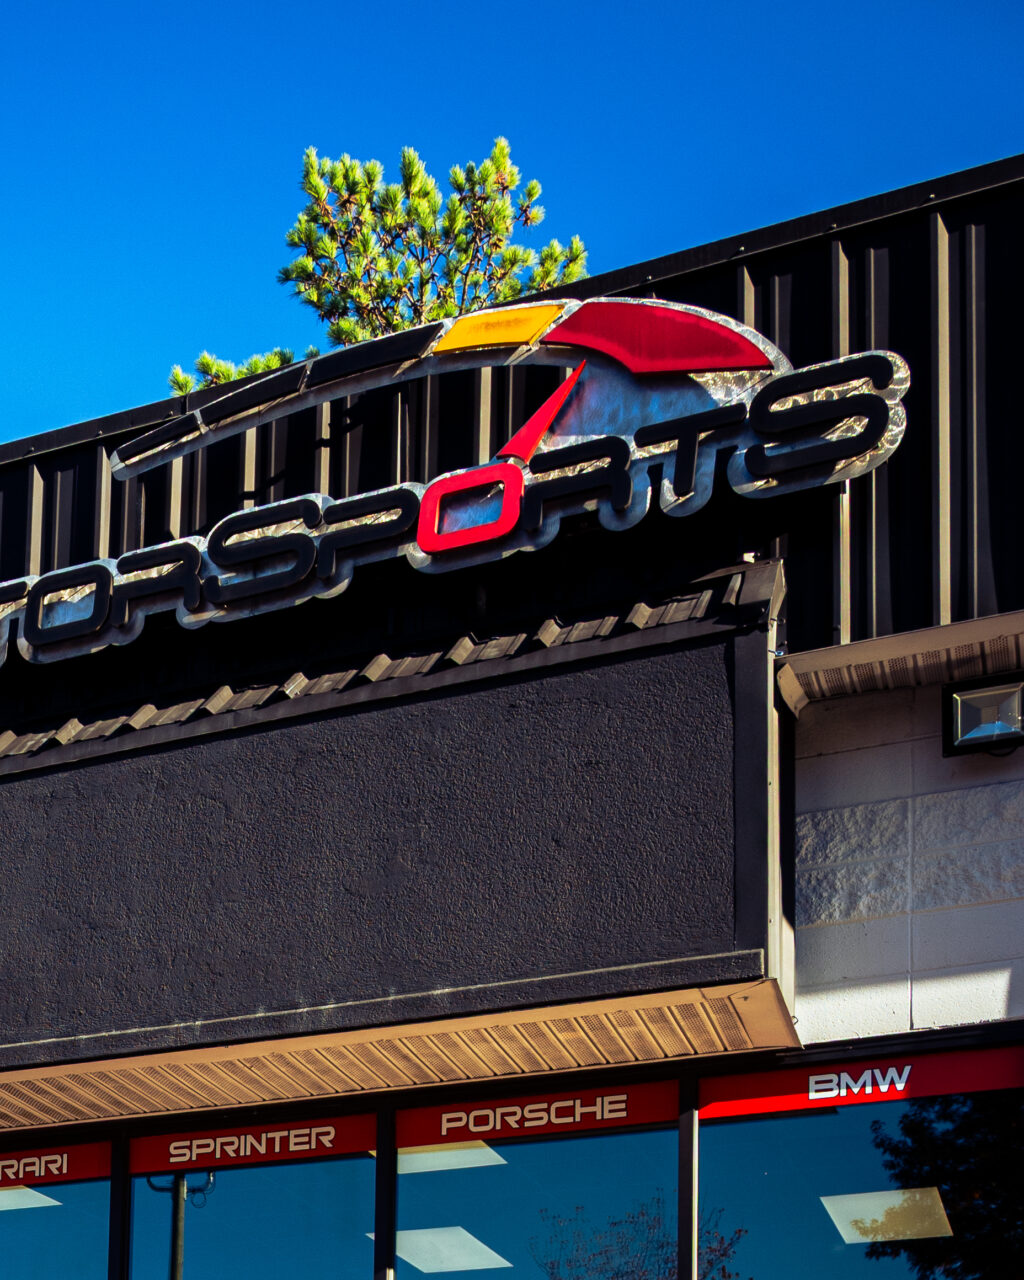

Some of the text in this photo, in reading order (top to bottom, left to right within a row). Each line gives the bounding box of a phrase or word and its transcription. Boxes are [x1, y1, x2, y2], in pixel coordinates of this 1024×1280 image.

[808, 1065, 912, 1100] BMW
[441, 1094, 628, 1136] PORSCHE
[169, 1126, 336, 1163] SPRINTER
